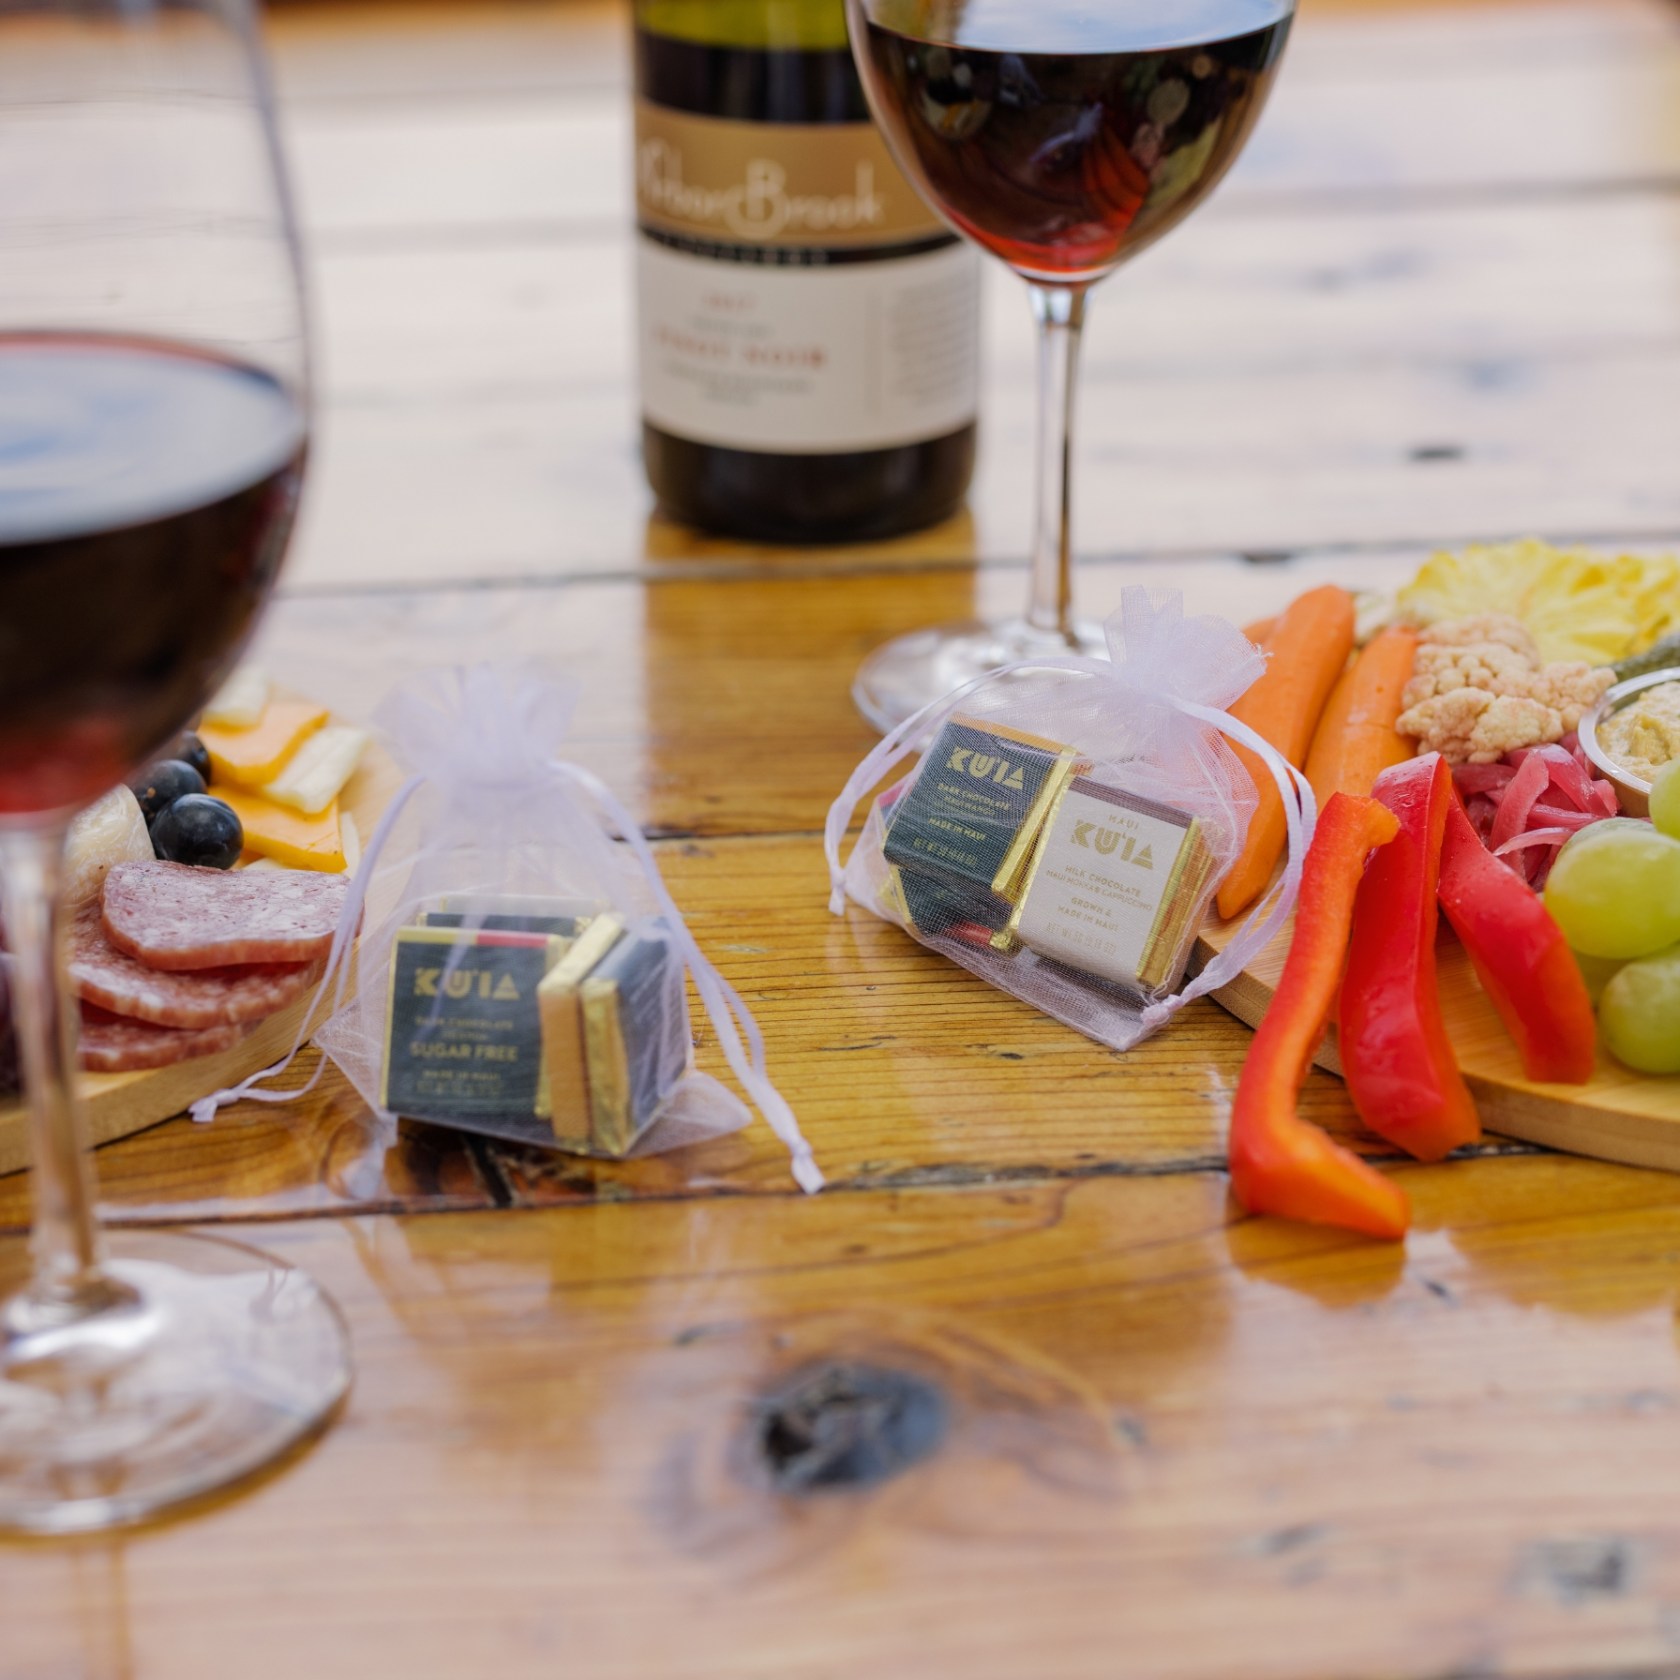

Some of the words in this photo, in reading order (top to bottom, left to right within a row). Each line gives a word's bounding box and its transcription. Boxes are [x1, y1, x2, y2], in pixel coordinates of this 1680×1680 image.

[961, 789, 1009, 810] CHOCOLATE
[928, 817, 951, 830] MADE
[952, 824, 962, 833] IN
[963, 828, 985, 841] MAUI
[1107, 813, 1139, 830] MAUI
[1045, 869, 1065, 881] MAUI
[1064, 864, 1086, 878] MILK
[1088, 872, 1141, 897] CHOCOLATE
[1070, 896, 1103, 913] GROWN
[1056, 904, 1081, 919] MADE
[1083, 913, 1093, 922] IN
[1095, 918, 1118, 931] MAUI
[410, 1041, 471, 1059] SUGAR
[474, 1044, 519, 1062] FREE
